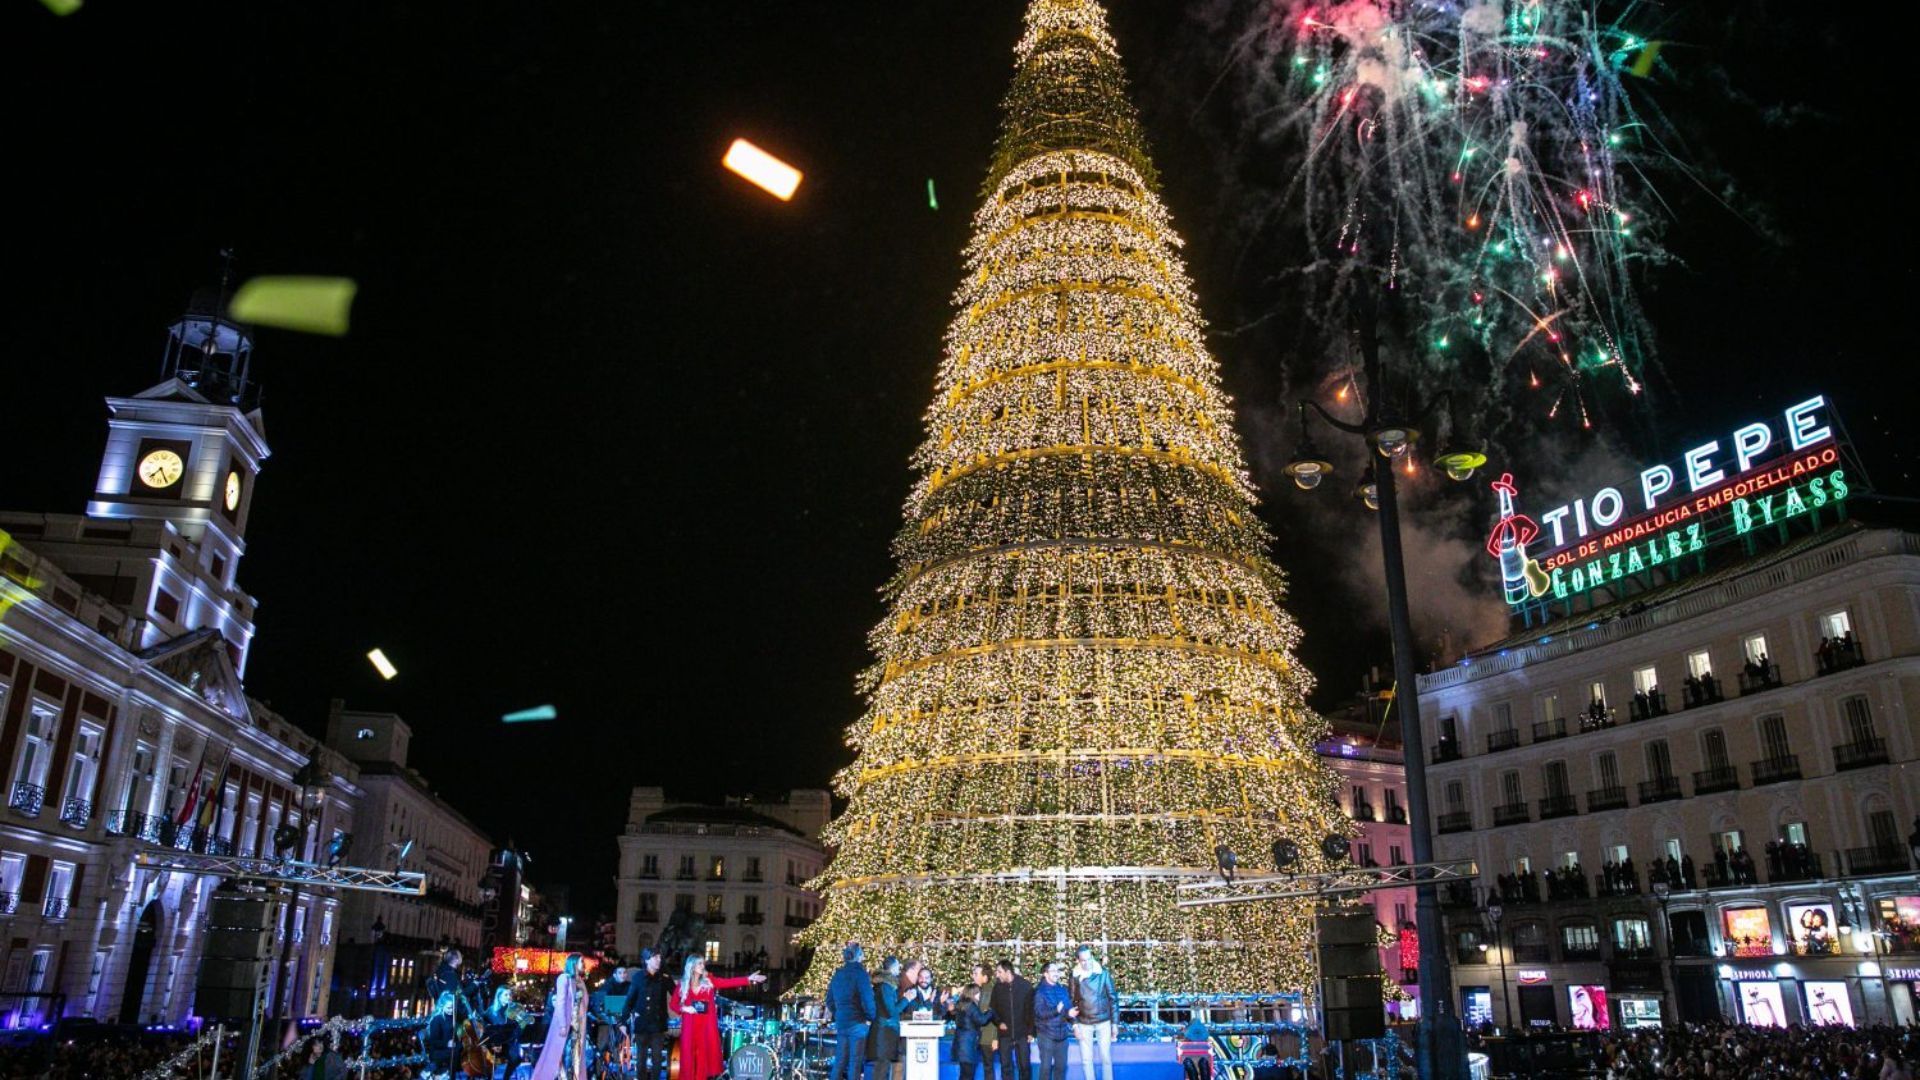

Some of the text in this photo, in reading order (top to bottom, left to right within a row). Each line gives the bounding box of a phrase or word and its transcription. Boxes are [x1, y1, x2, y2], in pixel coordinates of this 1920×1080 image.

[1542, 394, 1831, 546] TIO PEPE
[1547, 449, 1836, 571] SOL DE ANDALUCIA EMBOTELLADO
[1551, 470, 1848, 599] GONZALEZ BYASS
[1731, 969, 1774, 980] SEPHORA
[738, 1056, 764, 1073] WISH
